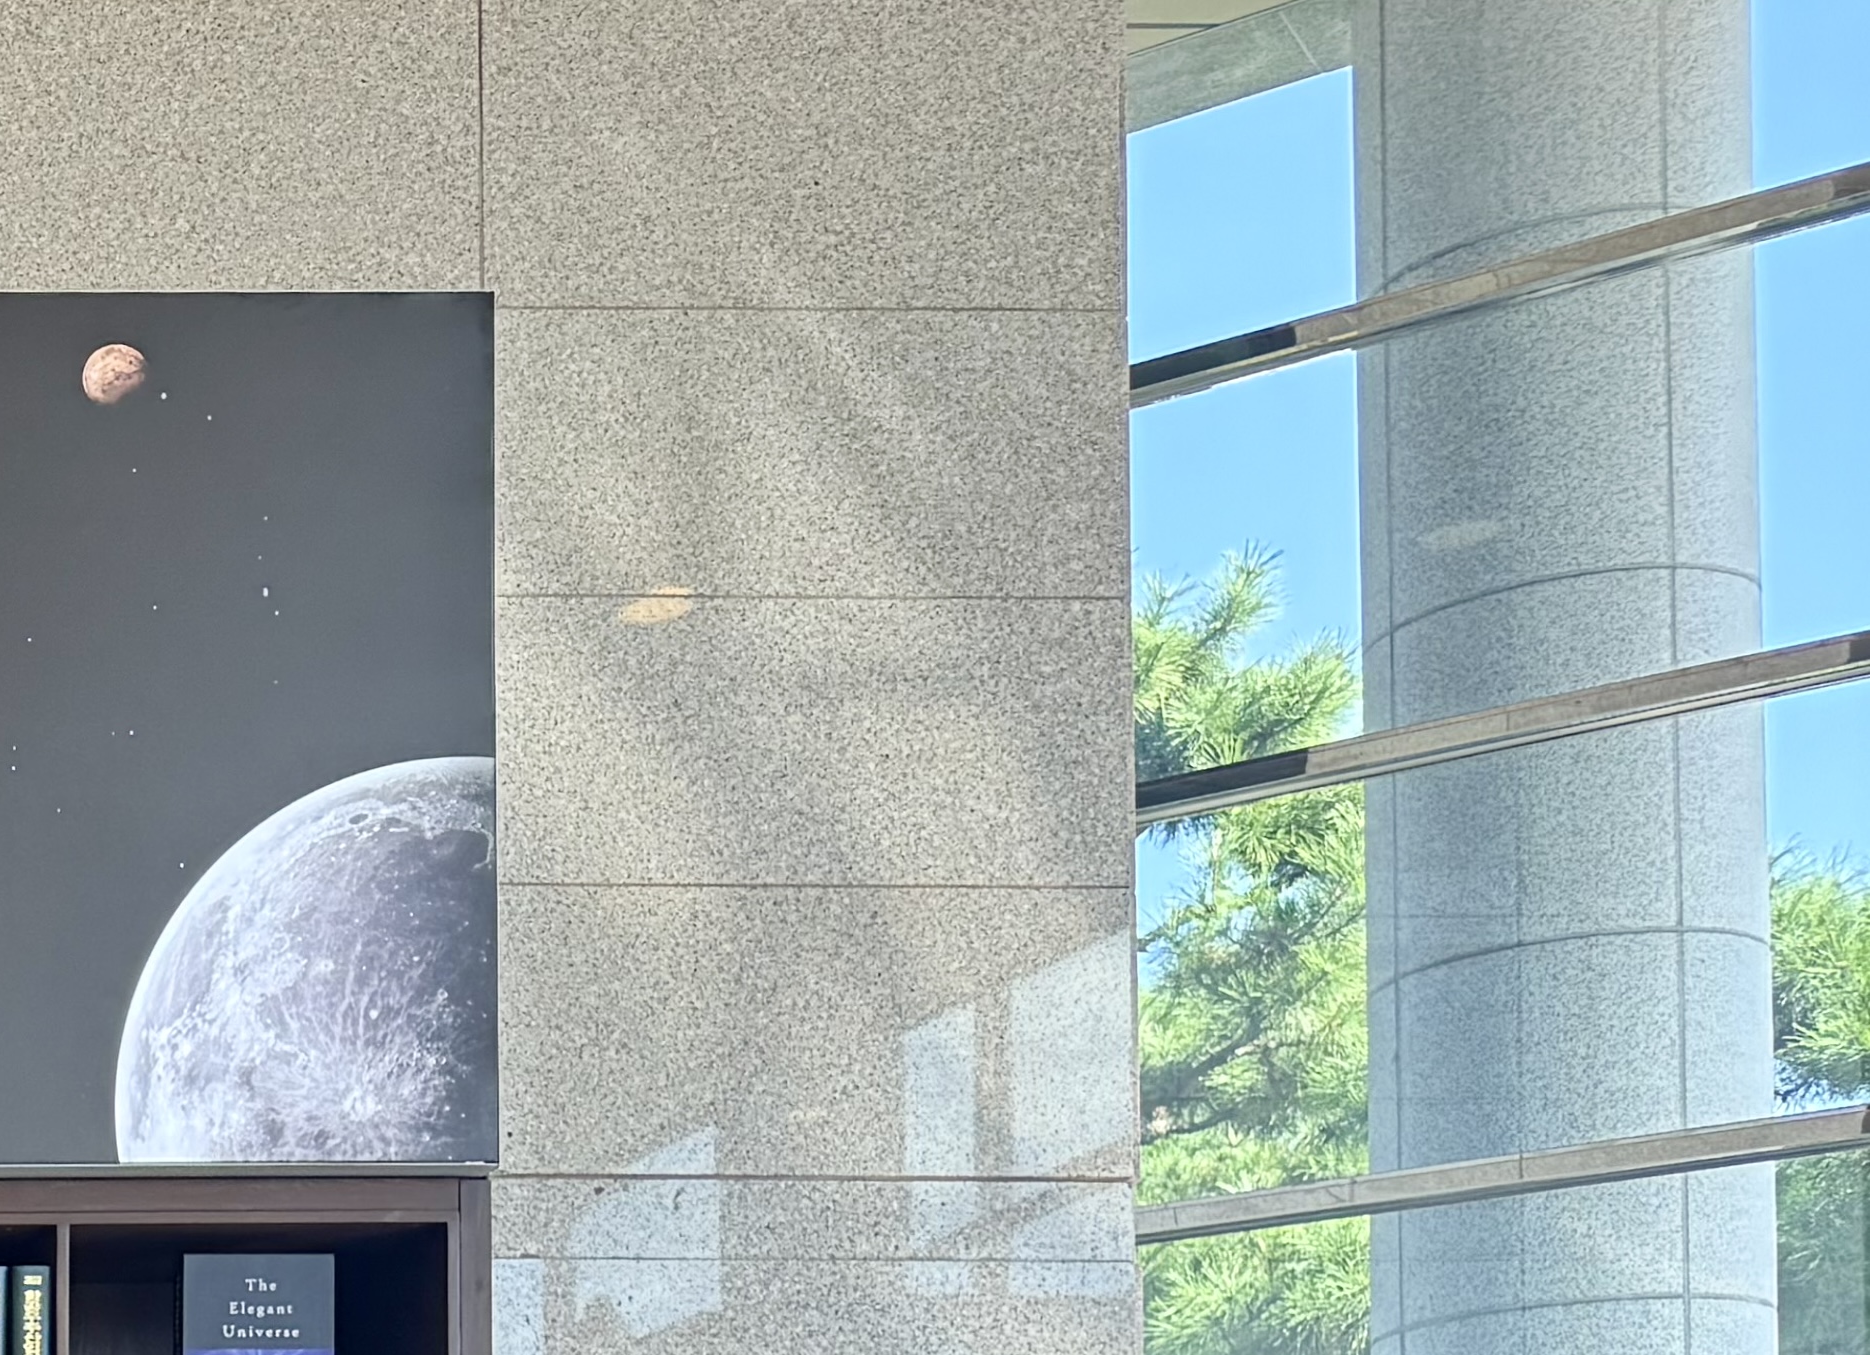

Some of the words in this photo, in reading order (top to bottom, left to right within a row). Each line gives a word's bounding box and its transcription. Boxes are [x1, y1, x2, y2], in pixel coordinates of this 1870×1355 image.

[244, 1278, 278, 1293] The
[228, 1301, 293, 1319] Elegant
[222, 1324, 301, 1339] Universe
